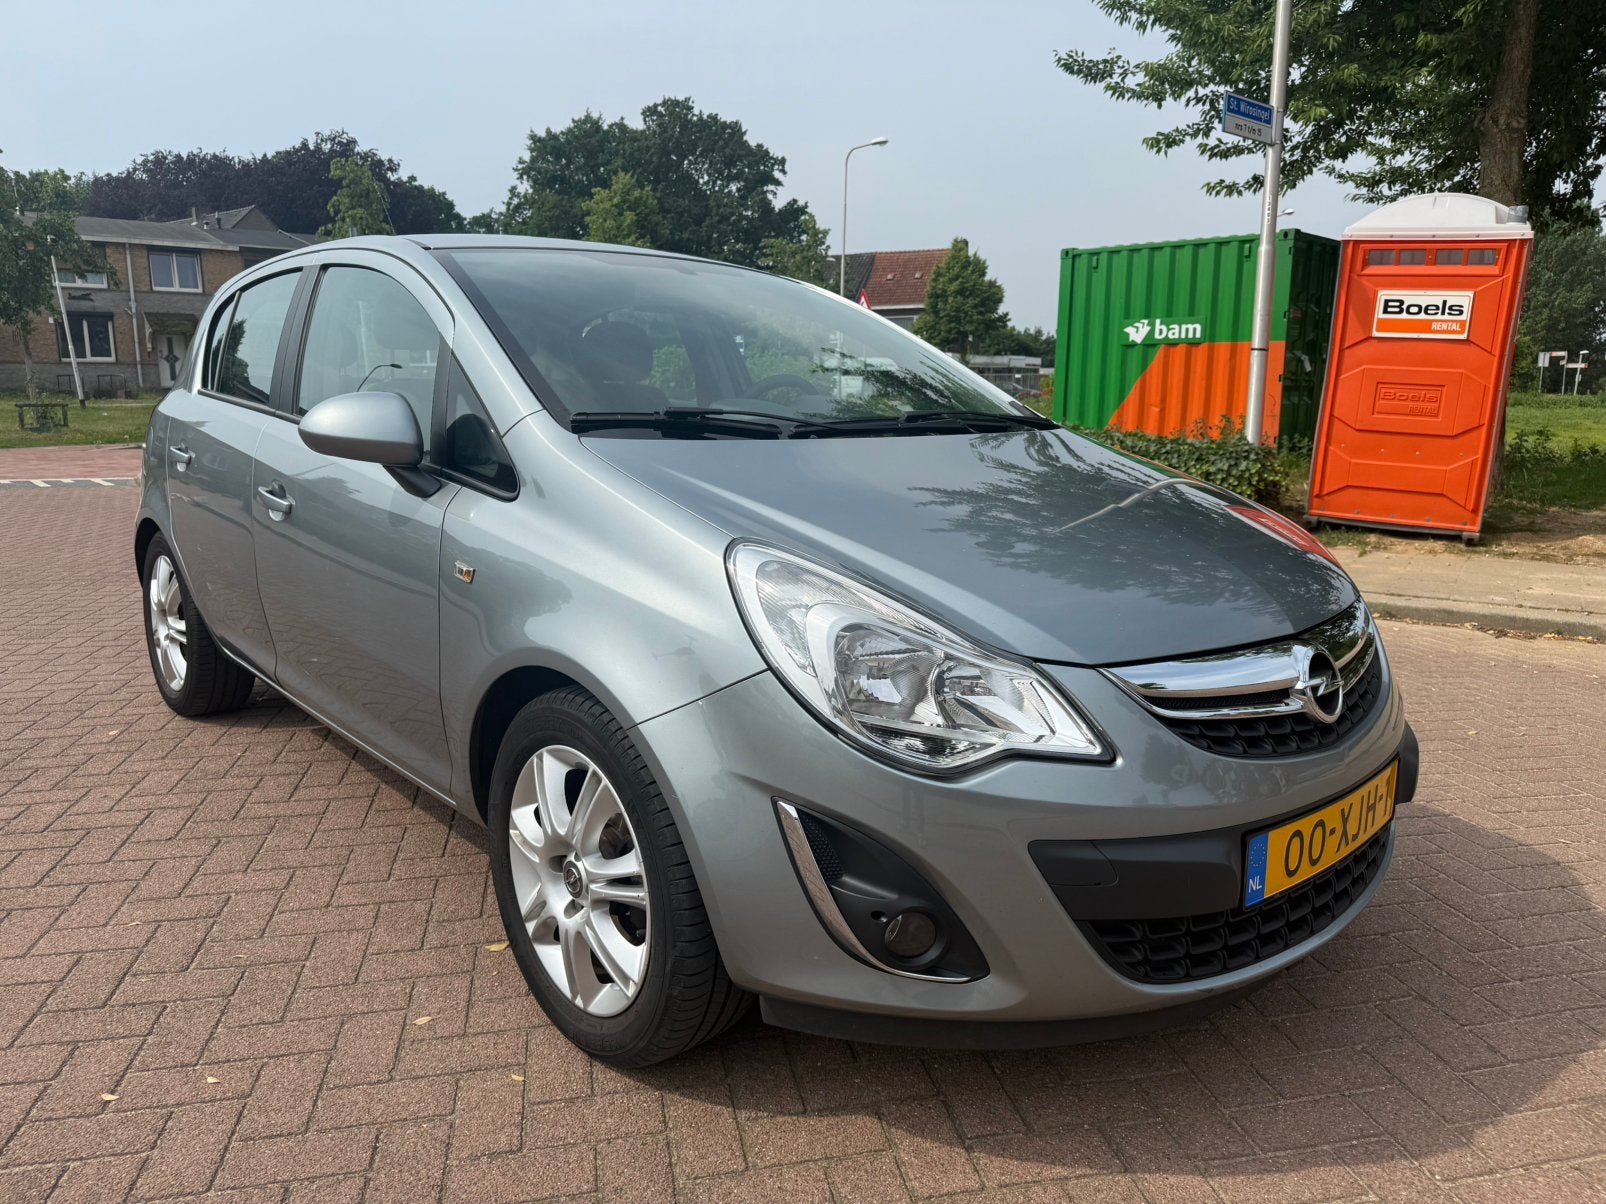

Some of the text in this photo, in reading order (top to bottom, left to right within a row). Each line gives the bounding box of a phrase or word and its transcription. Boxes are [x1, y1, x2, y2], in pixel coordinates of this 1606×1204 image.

[1240, 100, 1270, 122] Wirosingel
[1248, 125, 1256, 135] t/m
[1382, 298, 1465, 317] Boels
[1154, 318, 1202, 340] bam
[1431, 321, 1462, 331] RENTAL
[1380, 391, 1439, 403] Boels
[1408, 405, 1438, 416] RENTAL
[1284, 775, 1391, 879] 00-XJH-1
[1248, 875, 1263, 893] NL
